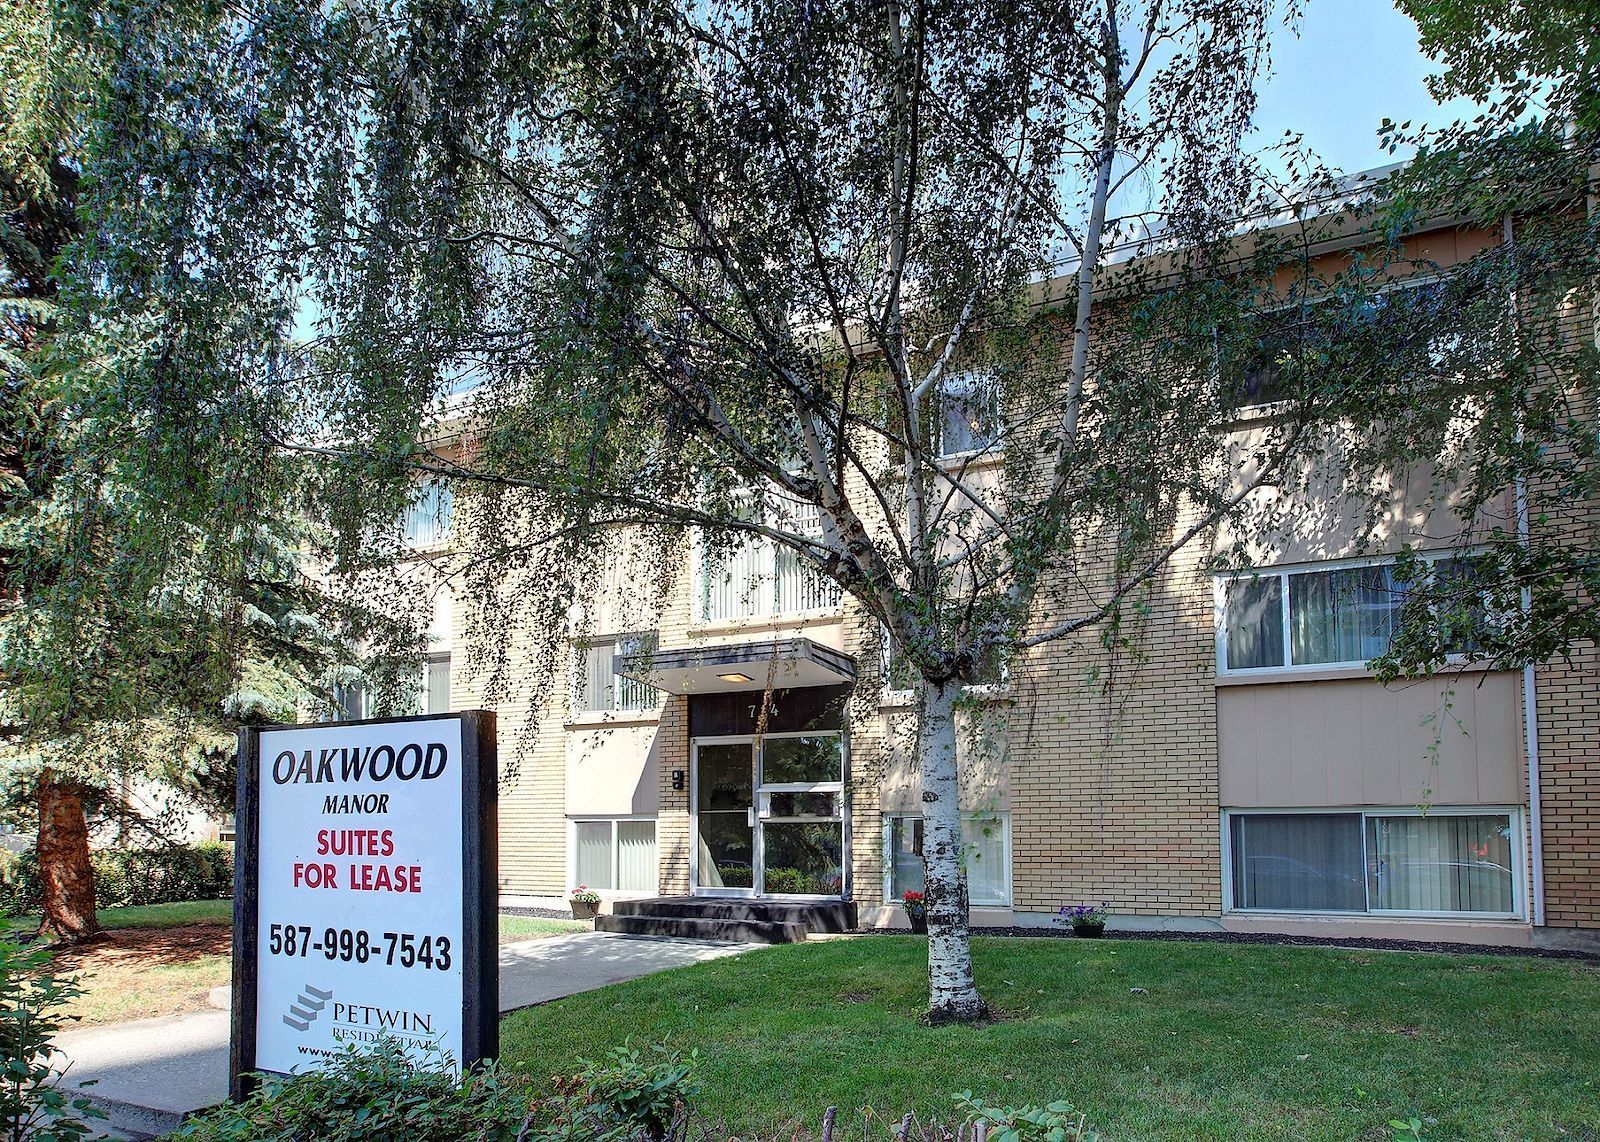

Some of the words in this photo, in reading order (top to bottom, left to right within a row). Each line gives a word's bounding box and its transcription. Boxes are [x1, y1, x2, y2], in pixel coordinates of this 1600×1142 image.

[747, 703, 779, 717] 74
[273, 743, 448, 784] OAKWOOD
[322, 794, 389, 814] MANOR
[317, 830, 394, 856] SUITES
[293, 863, 338, 889] FOR
[350, 865, 422, 893] LEASE
[269, 923, 452, 971] 587-998-7543
[332, 1002, 432, 1032] PETWIN
[332, 1027, 432, 1051] RESIDTIAL
